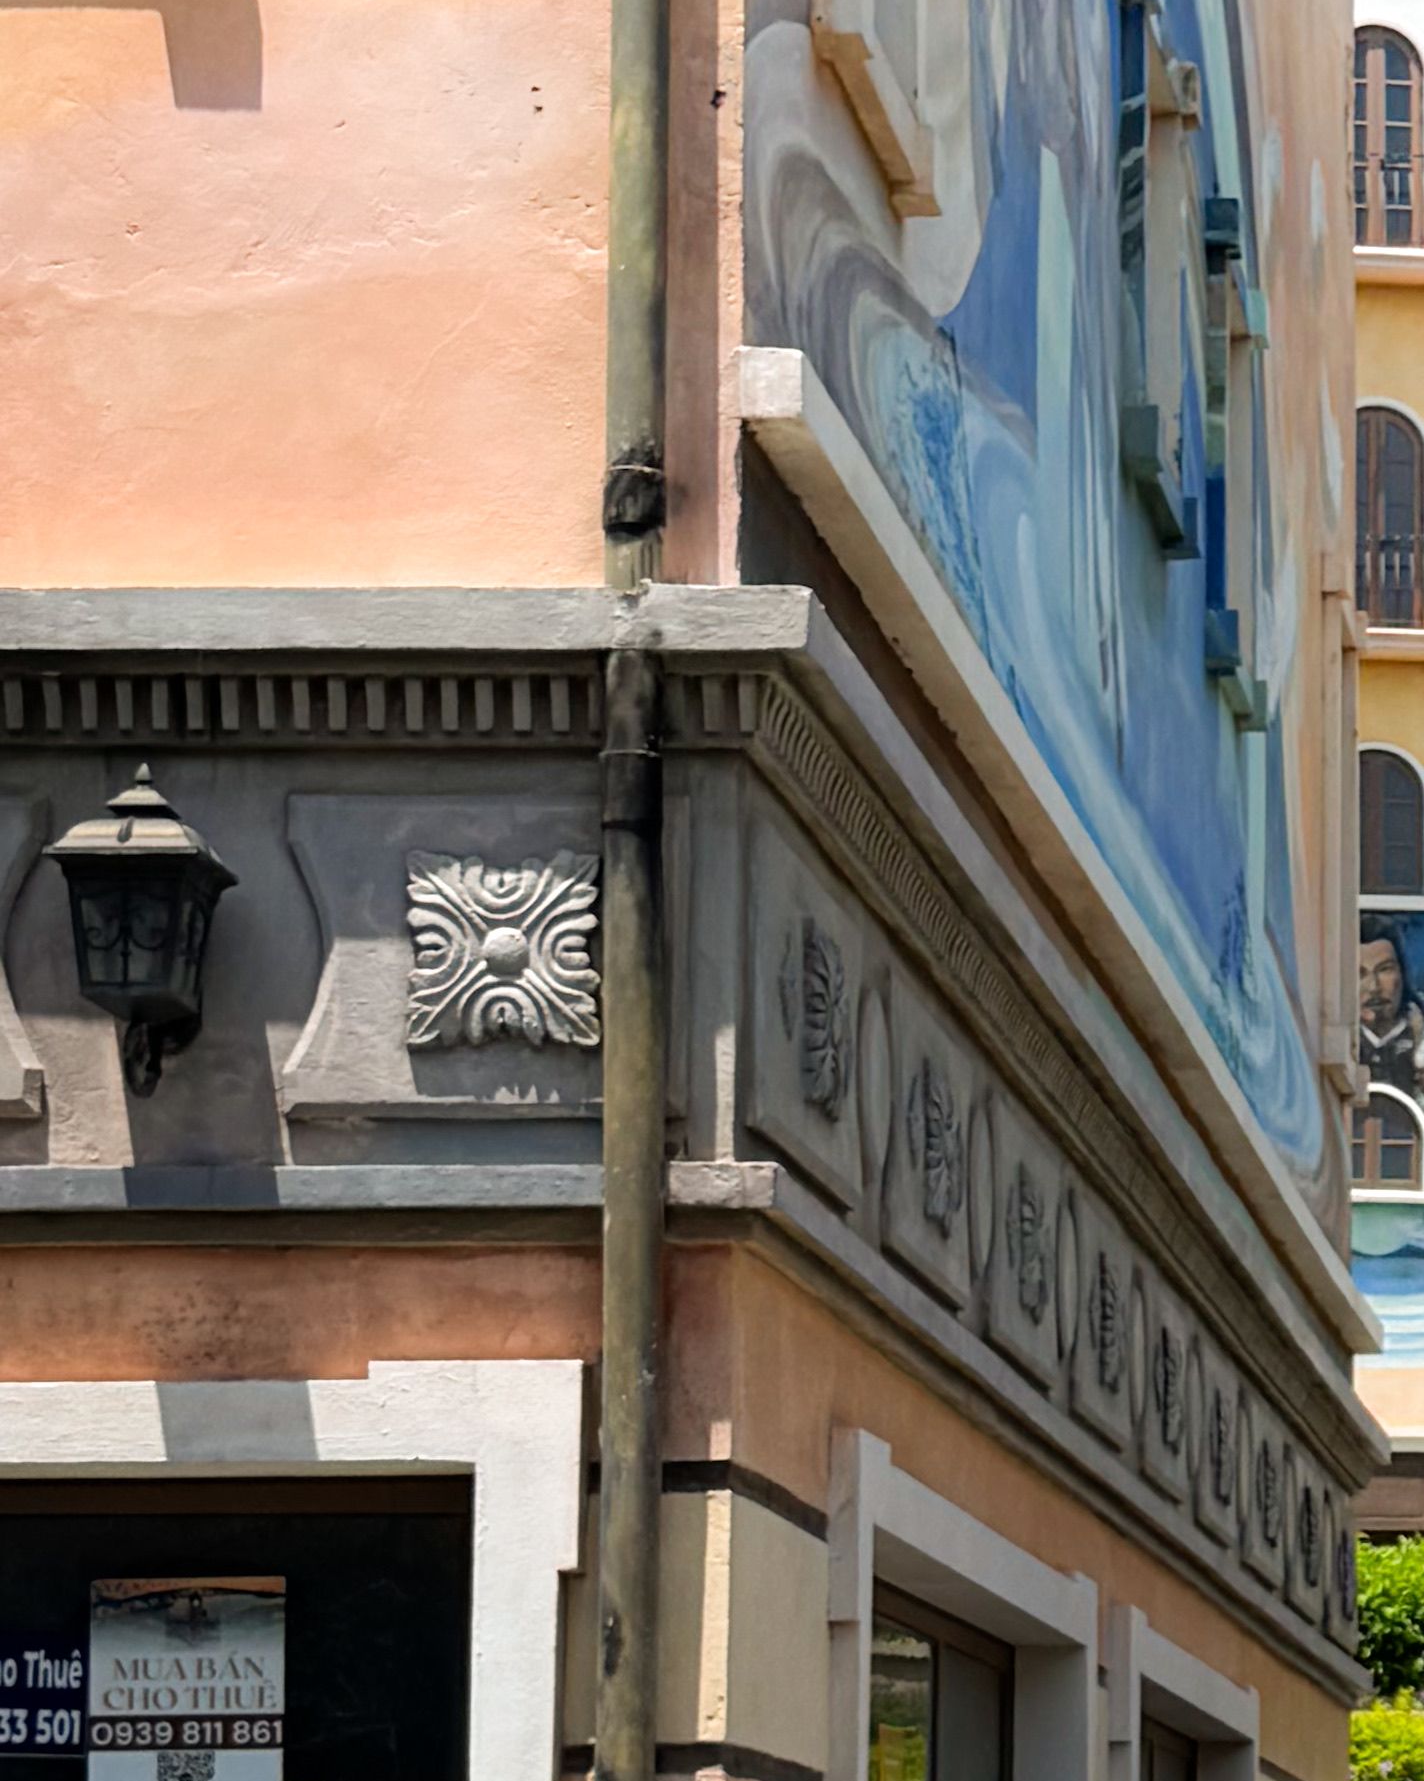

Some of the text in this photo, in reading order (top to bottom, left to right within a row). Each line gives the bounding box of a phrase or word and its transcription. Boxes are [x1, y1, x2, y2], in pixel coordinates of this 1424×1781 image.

[0, 1648, 84, 1690] o Thuê
[113, 1649, 267, 1682] MUA BÁN
[102, 1678, 278, 1711] CHO THUÊ
[35, 1708, 82, 1745] 501
[91, 1720, 284, 1746] 0939 811 861
